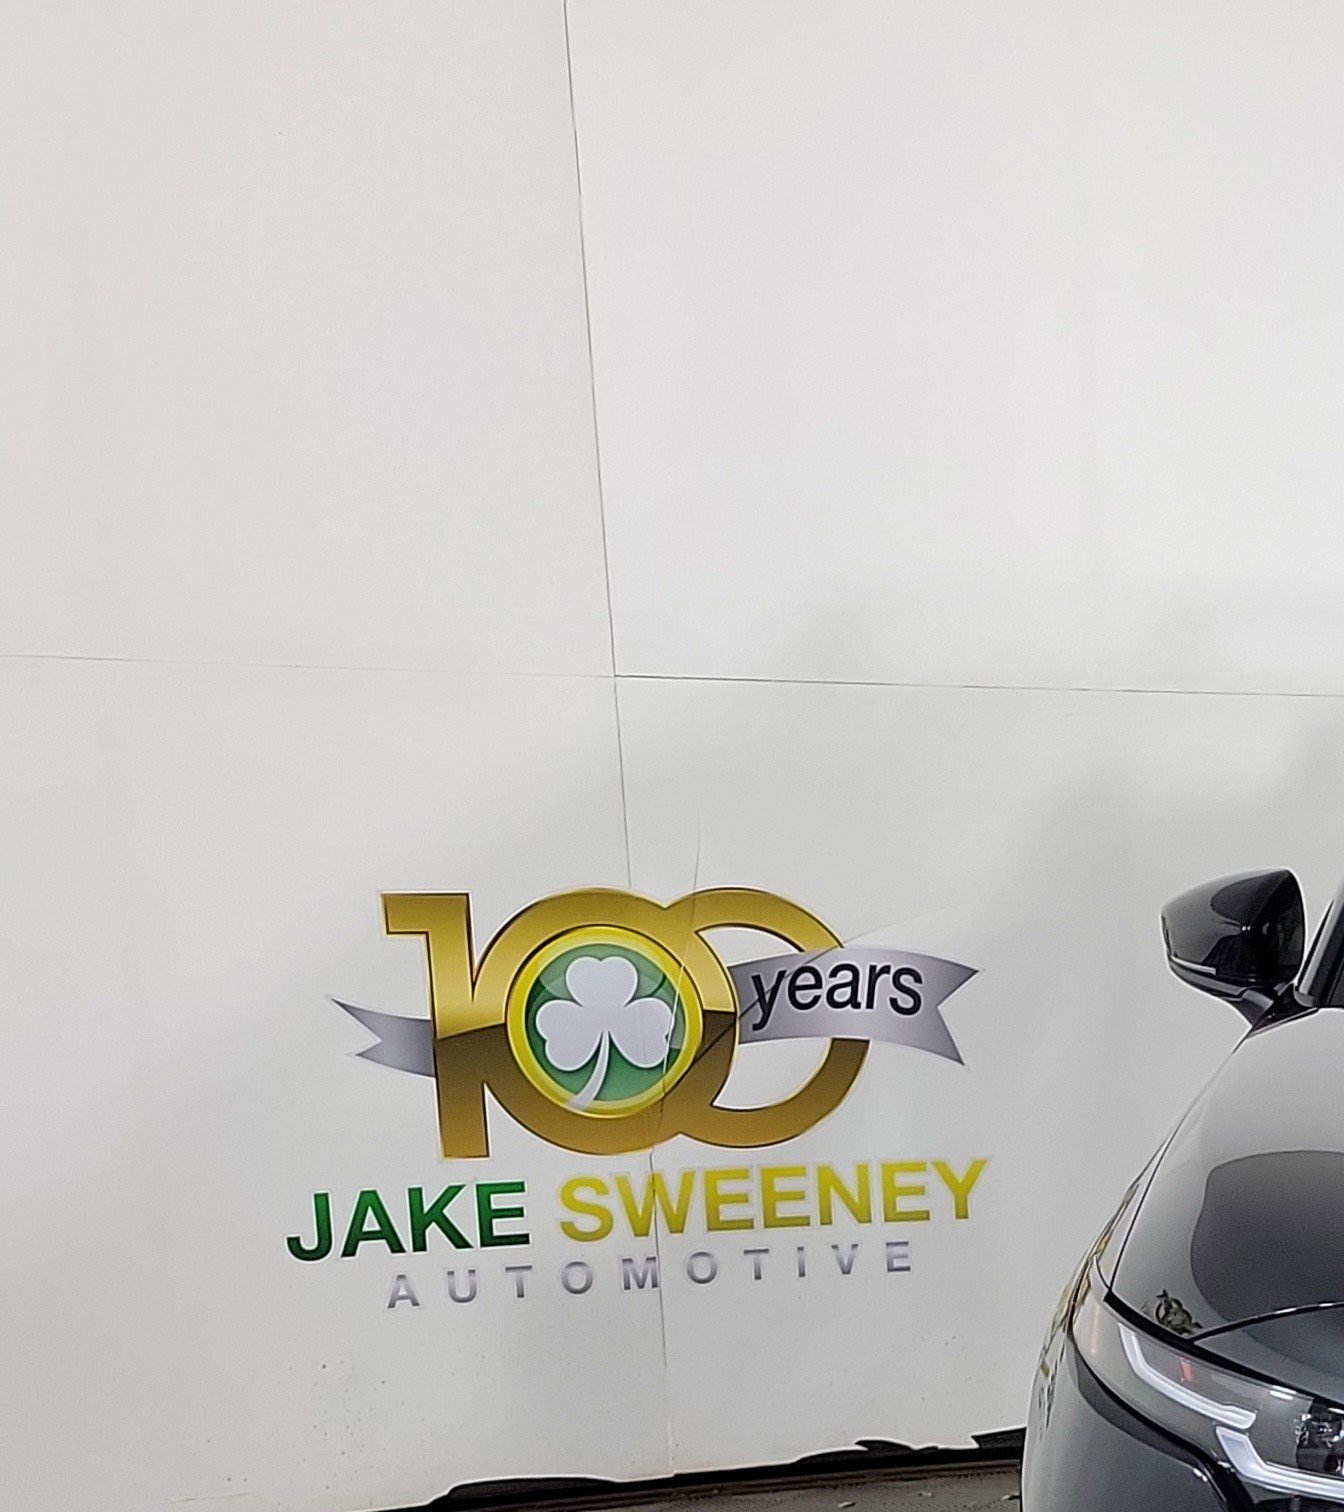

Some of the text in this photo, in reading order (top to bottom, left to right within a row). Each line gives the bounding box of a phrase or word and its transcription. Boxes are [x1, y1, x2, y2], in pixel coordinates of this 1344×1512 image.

[380, 886, 923, 1160] 100 years
[286, 1159, 989, 1262] JAKE SWEENEY
[386, 1241, 912, 1309] AUTOMOTIVE
